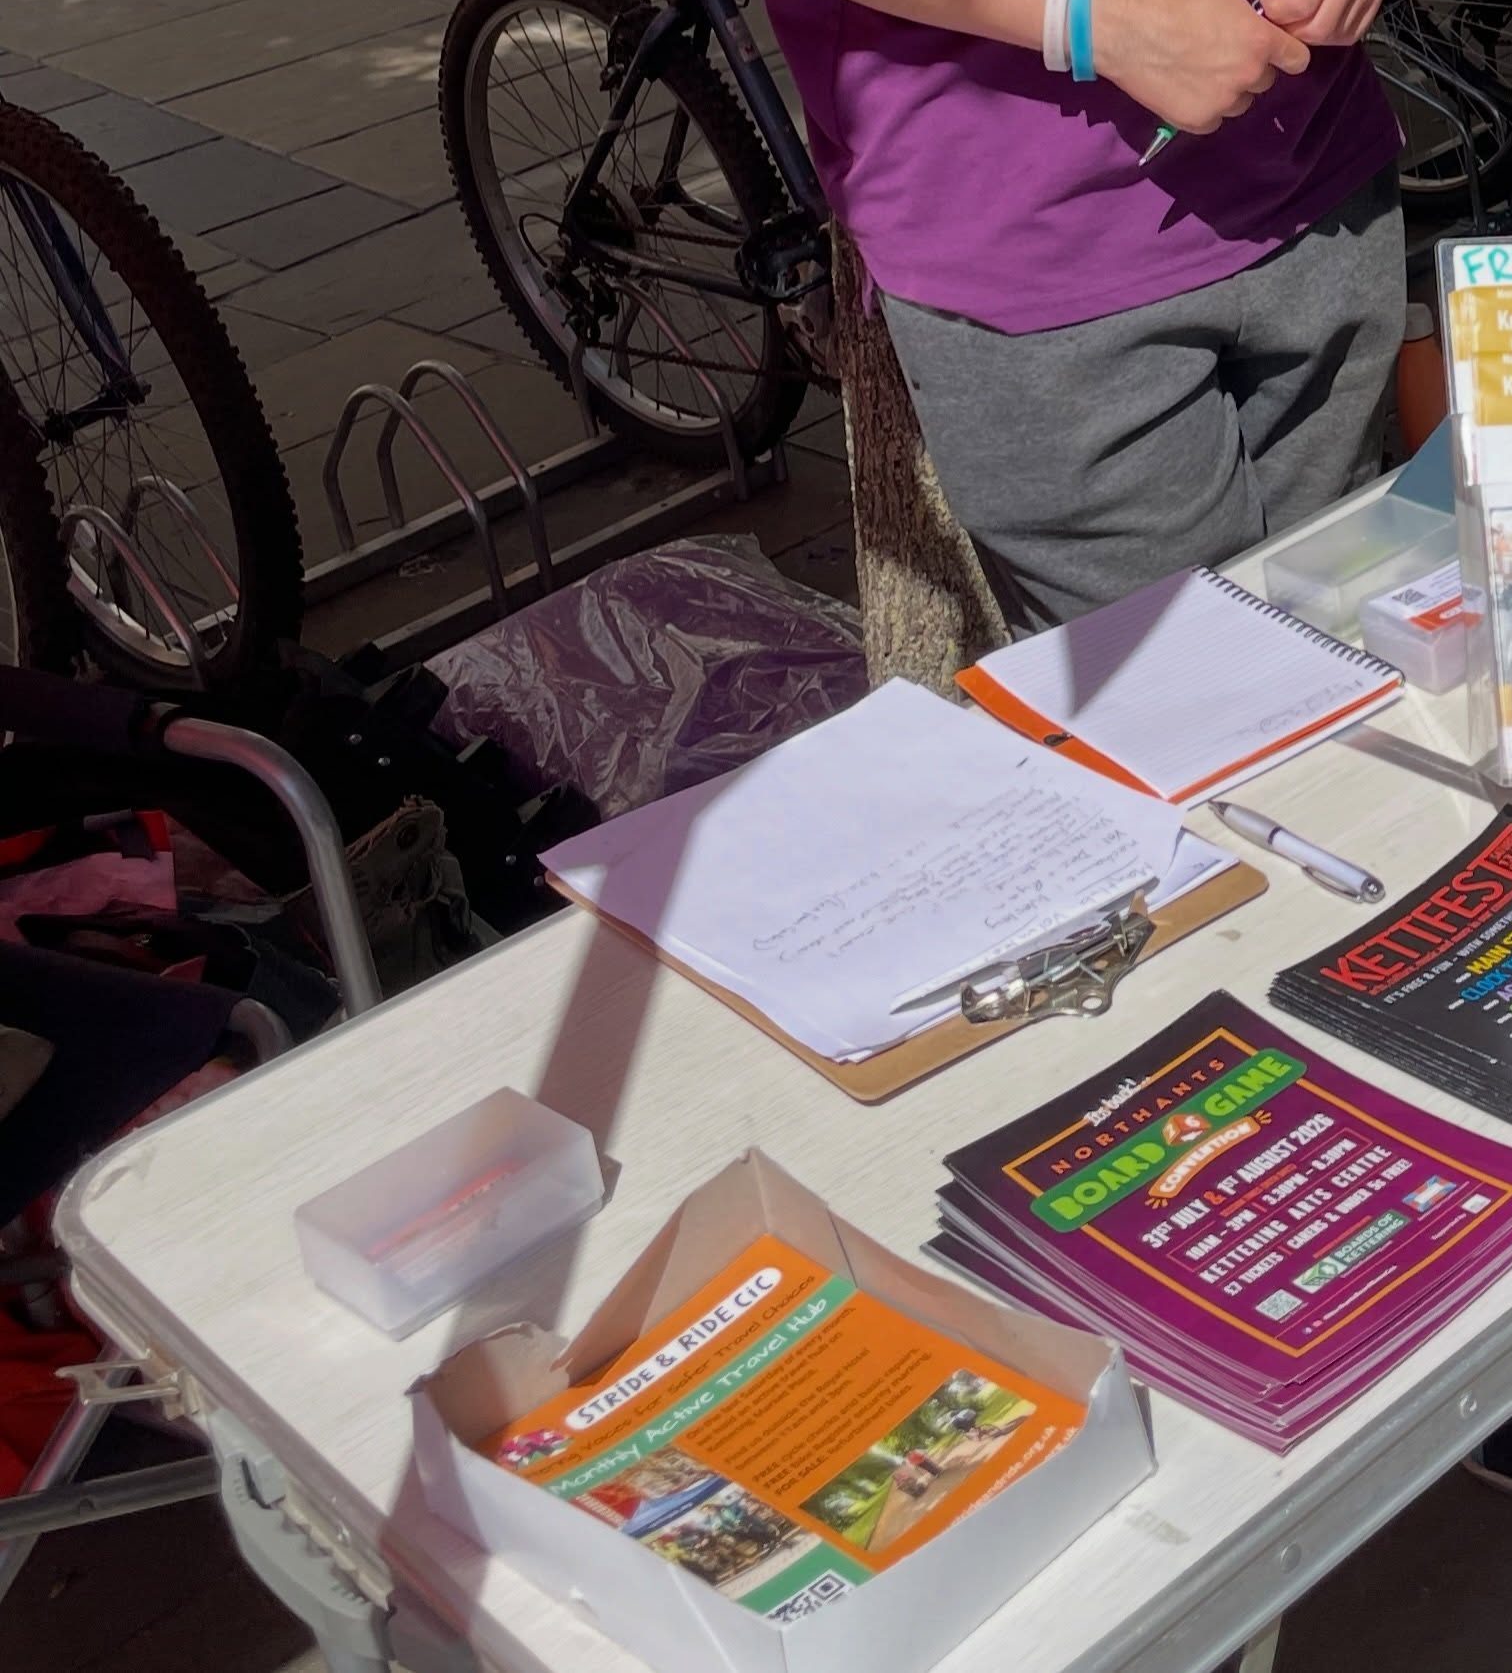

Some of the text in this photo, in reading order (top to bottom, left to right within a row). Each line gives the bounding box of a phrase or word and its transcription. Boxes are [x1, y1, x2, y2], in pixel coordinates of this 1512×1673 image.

[1400, 977, 1426, 992] FREE
[1431, 960, 1453, 974] FUN
[1456, 938, 1483, 956] WITH
[1461, 969, 1511, 1000] CLOCK
[1466, 945, 1510, 974] MAIN
[1050, 1143, 1164, 1219] BOARD
[1204, 1056, 1290, 1115] GAME
[1051, 1060, 1223, 1173] NORTHANTS
[1158, 1123, 1255, 1192] CONVENTION
[1170, 1199, 1209, 1228] JULY
[1203, 1191, 1226, 1204] &
[1216, 1175, 1238, 1194] 1ST
[1237, 1138, 1296, 1182] AUGUST
[1289, 1113, 1333, 1144] 2026
[1186, 1234, 1221, 1259] 10AM
[1225, 1209, 1256, 1230] 3PM
[1262, 1173, 1307, 1204] 3.30PM
[1199, 1220, 1287, 1282] KETTERING
[1288, 1188, 1331, 1219] ARTS
[1331, 1146, 1391, 1187] CENTRE
[1238, 1252, 1283, 1282] TICKETS
[1287, 1219, 1327, 1248] CARERS
[1324, 1212, 1340, 1222] &
[1335, 1188, 1371, 1213] UNDER
[1381, 1158, 1412, 1179] FREE!
[1334, 1226, 1378, 1257] BOARDS
[1377, 1213, 1392, 1226] OF
[1343, 1218, 1403, 1262] KETTERING
[633, 1395, 661, 1416] for
[666, 1359, 709, 1394] Safer
[714, 1320, 761, 1356] Travel
[761, 1275, 814, 1320] Choices
[655, 1354, 676, 1367] &
[548, 1444, 641, 1495] Monthly
[645, 1391, 713, 1442] Active
[718, 1333, 786, 1385] Travel
[786, 1298, 826, 1331] Hub
[752, 1461, 779, 1482] FREE
[857, 1378, 883, 1398] basic
[774, 1477, 798, 1495] FOR
